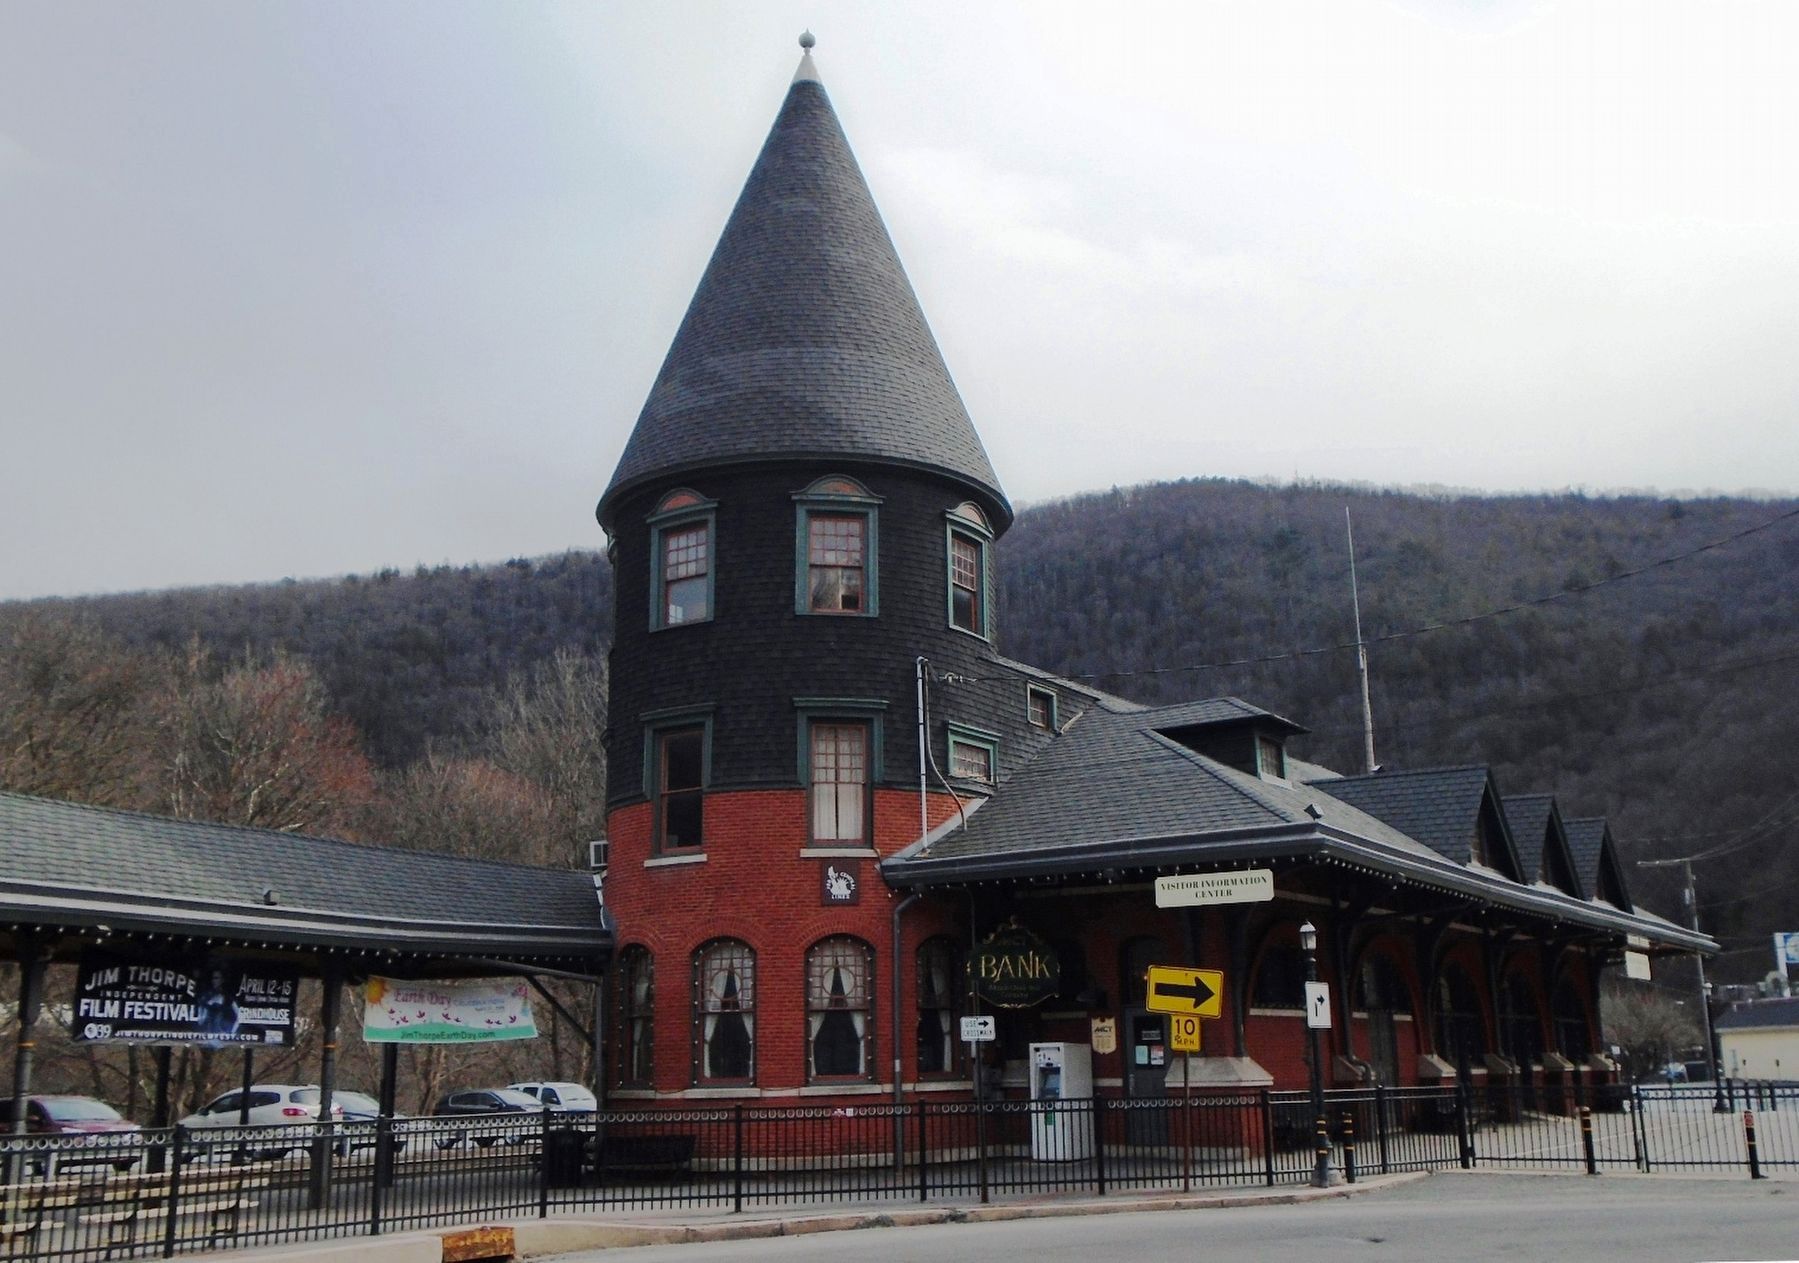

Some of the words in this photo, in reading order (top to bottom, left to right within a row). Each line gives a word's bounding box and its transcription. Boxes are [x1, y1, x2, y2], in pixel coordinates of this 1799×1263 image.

[1160, 880, 1199, 891] VISITOR
[1200, 876, 1268, 889] INFORMATION
[1195, 889, 1233, 898] CENTER
[981, 950, 1050, 983] BANK
[85, 967, 120, 991] JIM
[128, 966, 197, 997] THORPE
[100, 990, 183, 1001] INDEPENDENT
[79, 998, 120, 1018] FILM
[124, 1001, 200, 1022] FESTIVAL
[1175, 1018, 1195, 1035] 10
